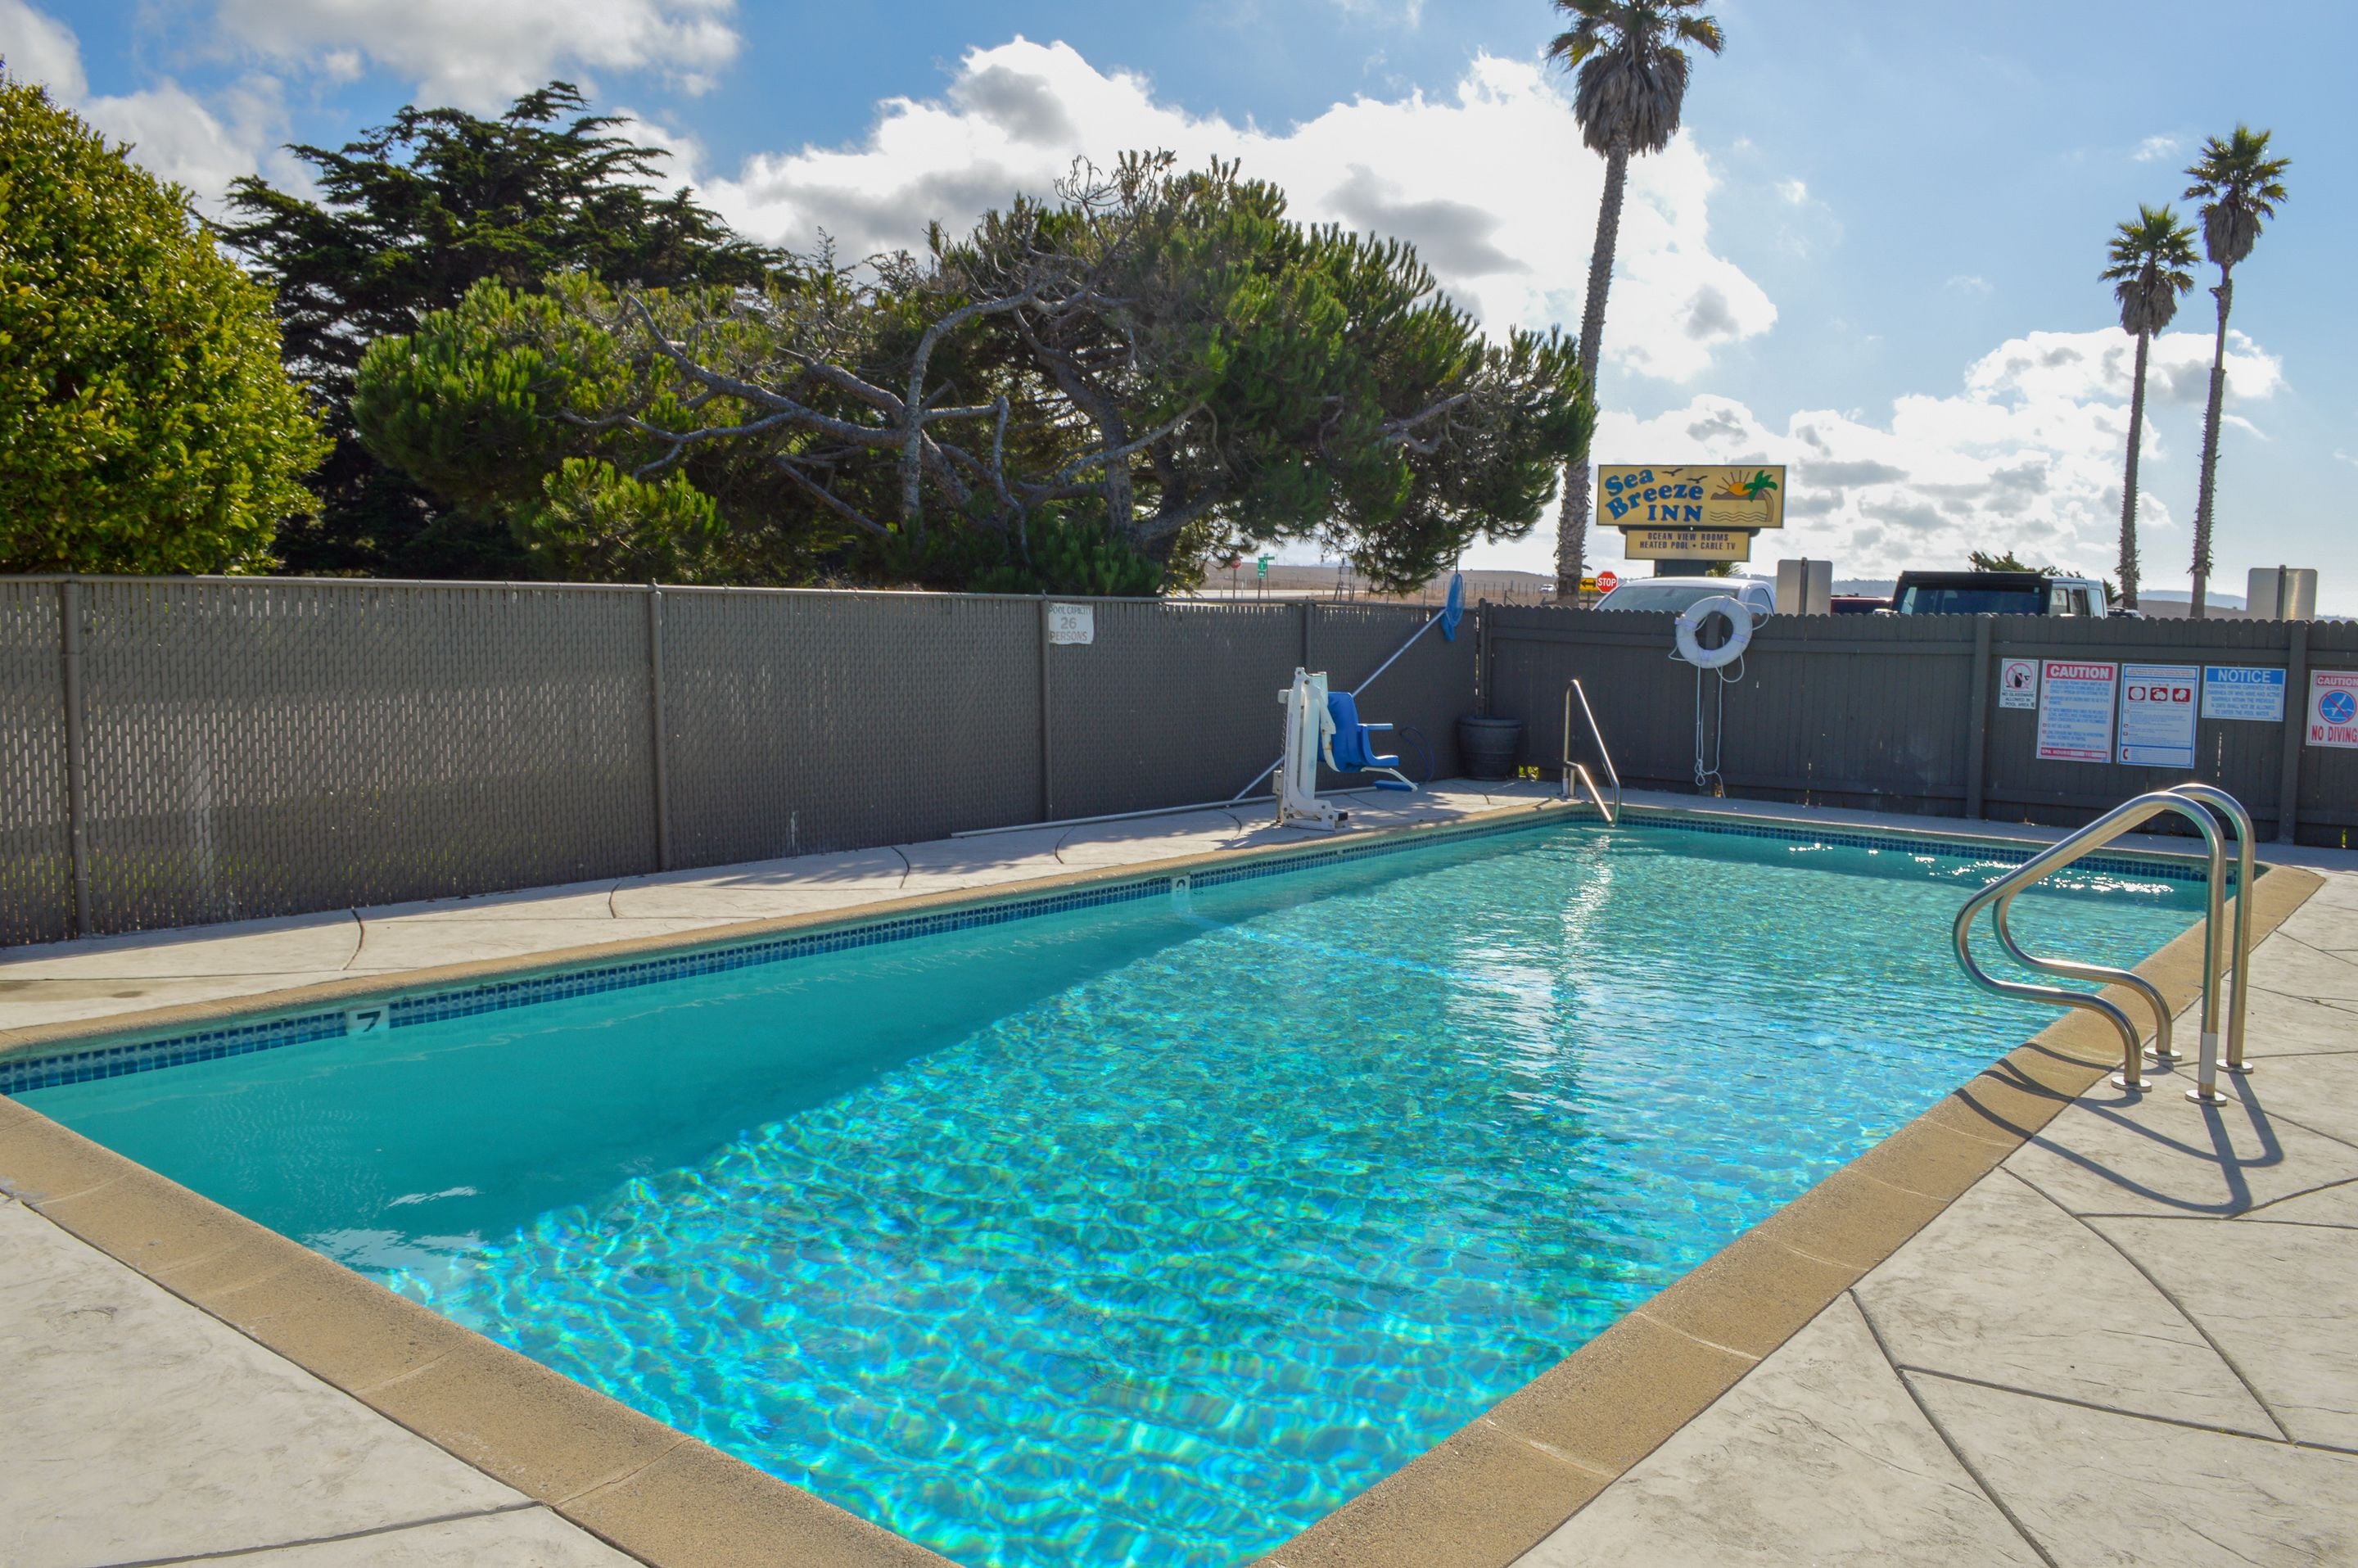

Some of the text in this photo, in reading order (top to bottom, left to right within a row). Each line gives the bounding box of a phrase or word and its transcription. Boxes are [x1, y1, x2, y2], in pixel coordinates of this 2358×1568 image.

[1605, 469, 1655, 497] Sea
[1605, 484, 1704, 520] Breeze
[1647, 504, 1703, 522] INN
[1598, 577, 1617, 587] STOP
[1060, 617, 1077, 629] 26
[1050, 631, 1088, 641] PERSONS
[2050, 665, 2109, 679] CAUTION
[2217, 669, 2272, 683] NOTICE
[2317, 676, 2358, 686] CAUTION
[2311, 725, 2358, 743] NO DIVING
[357, 1010, 381, 1033] 7
